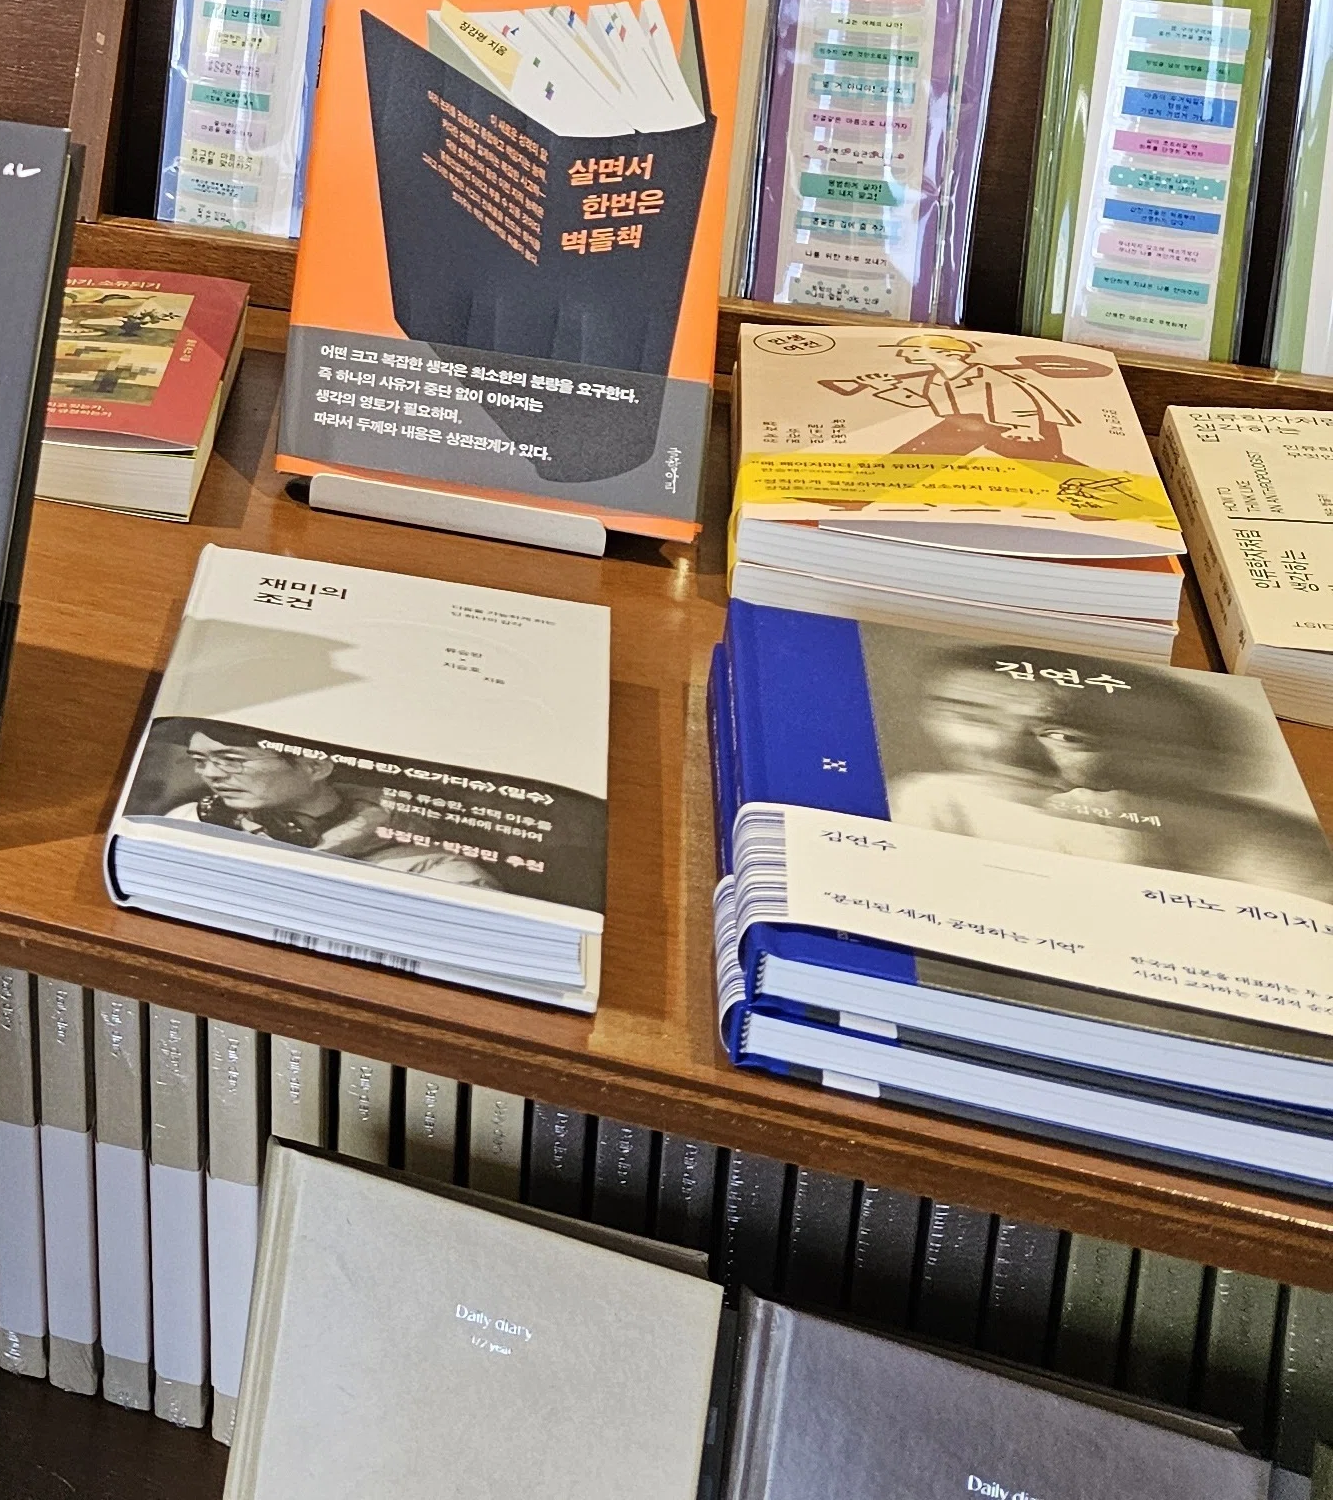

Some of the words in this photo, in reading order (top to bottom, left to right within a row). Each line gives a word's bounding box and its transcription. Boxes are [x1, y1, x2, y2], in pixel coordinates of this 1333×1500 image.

[458, 19, 490, 47] 장강명
[489, 37, 509, 57] 지음
[568, 155, 654, 186] 살면서
[581, 190, 665, 220] 한번은
[561, 225, 643, 255] 벽돌책
[97, 279, 160, 290] 소유되기
[318, 365, 333, 381] 즉
[336, 369, 376, 387] 하나의
[379, 375, 420, 395] 사유가
[423, 382, 452, 399] 중단
[456, 386, 484, 403] 없이
[487, 391, 544, 413] 이어지는
[320, 344, 348, 361] 어떤
[350, 349, 378, 365] 크고
[381, 351, 423, 371] 복잡한
[426, 358, 468, 379] 생각은
[471, 365, 527, 388] 최소한의
[531, 373, 574, 395] 분량을
[577, 381, 639, 404] 요구한다.
[316, 388, 356, 407] 생각의
[359, 394, 400, 413] 영토가
[403, 401, 462, 425] 필요하며,
[314, 410, 353, 429] 따라서
[356, 417, 398, 436] 두께와
[401, 424, 443, 444] 내용은
[447, 430, 516, 455] 상관관계가
[519, 443, 552, 462] 있다.
[1192, 423, 1302, 436] 생각하는
[1196, 433, 1221, 443] 법
[1232, 528, 1281, 589] 인류학자처럼
[1280, 549, 1321, 592] 생각하는
[253, 591, 315, 612] 조건
[258, 576, 349, 601] 재미의
[994, 660, 1132, 695] 김연수
[471, 803, 500, 819] 선택
[1118, 808, 1162, 828] 세계
[819, 830, 897, 853] 김연수
[506, 853, 545, 873] 추천
[1141, 890, 1226, 913] 히라노
[897, 905, 943, 928] 세계,
[946, 917, 1031, 945] 공명하는
[454, 1303, 491, 1331] Daily
[493, 1317, 535, 1345] diary
[967, 1475, 1009, 1500] Daily
